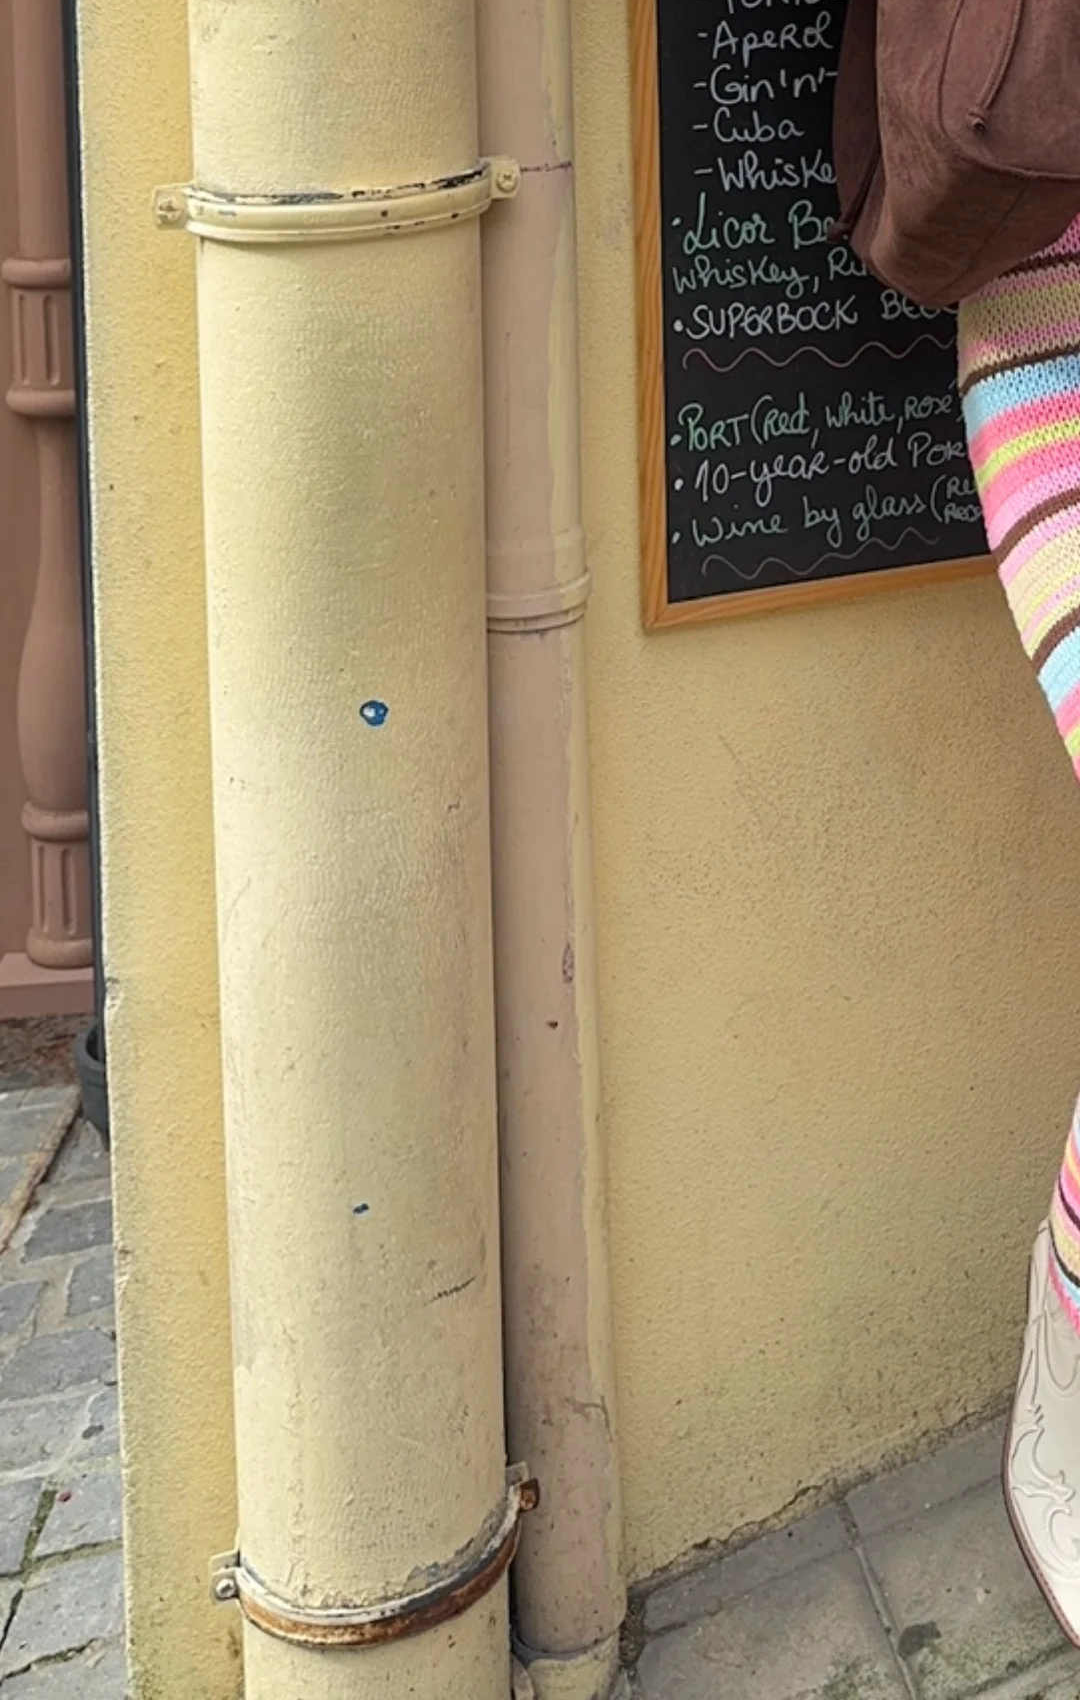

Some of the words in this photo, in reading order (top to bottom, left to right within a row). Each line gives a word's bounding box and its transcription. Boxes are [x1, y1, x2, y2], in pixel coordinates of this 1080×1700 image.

[713, 106, 805, 143] Cuba
[683, 192, 776, 255] Licor
[803, 496, 842, 548] by
[853, 484, 926, 540] glass
